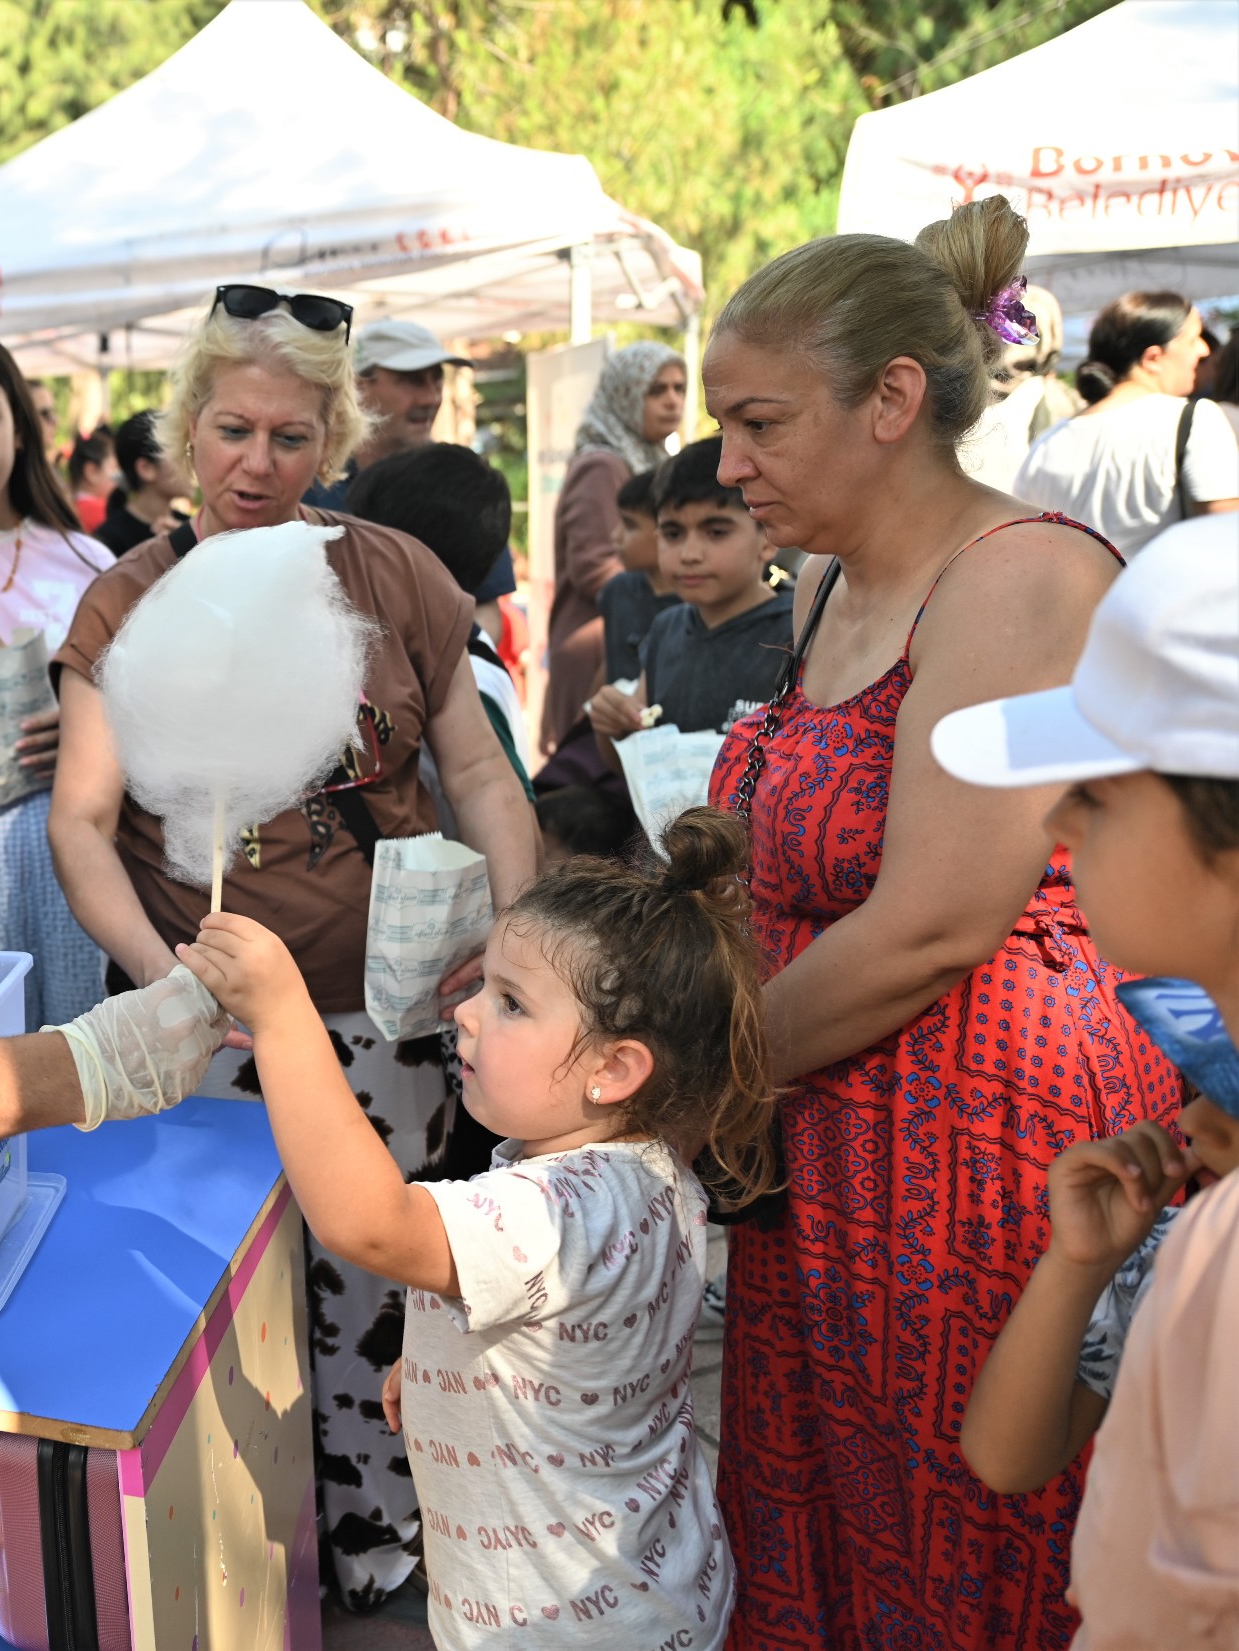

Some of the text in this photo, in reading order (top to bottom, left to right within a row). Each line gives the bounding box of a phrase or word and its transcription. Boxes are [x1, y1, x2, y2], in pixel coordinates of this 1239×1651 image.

[524, 1270, 549, 1310] NYC
[558, 1321, 609, 1343] NYC
[511, 1373, 650, 1407] NYC NYC
[647, 1401, 671, 1440] NYC
[428, 1439, 460, 1468] NYC
[636, 1457, 678, 1502] NYC
[568, 1584, 619, 1622] NYC
[640, 1538, 666, 1585] NYC
[698, 1551, 718, 1602] NYC
[461, 1598, 501, 1628] NYC
